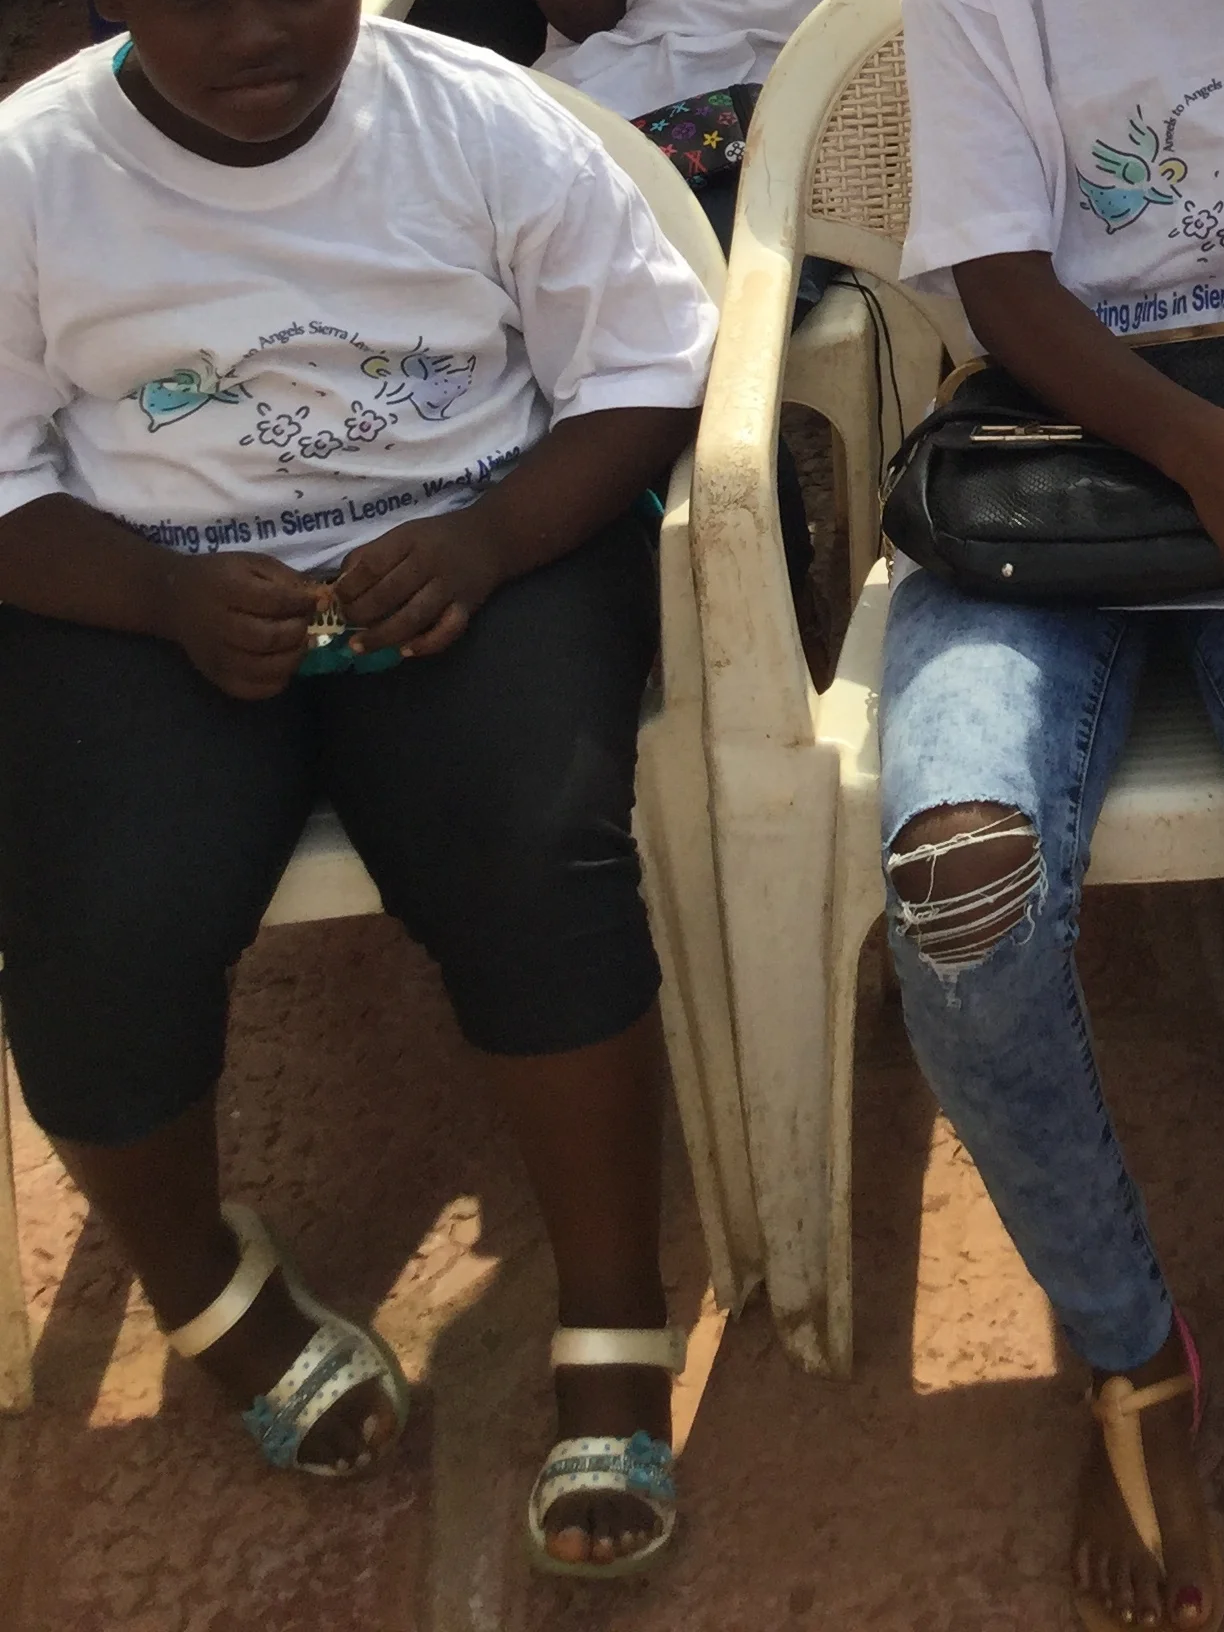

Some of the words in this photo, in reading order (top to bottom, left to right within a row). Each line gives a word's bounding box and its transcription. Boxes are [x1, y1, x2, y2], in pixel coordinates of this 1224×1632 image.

[1172, 104, 1185, 117] to
[1183, 78, 1223, 107] Angels
[1132, 293, 1168, 329] girls
[1172, 291, 1187, 316] in
[258, 321, 305, 349] Angels
[308, 320, 349, 340] Sierra
[204, 518, 252, 554] girls
[254, 515, 277, 540] in
[280, 506, 346, 536] Sierra
[348, 492, 419, 522] Leone,
